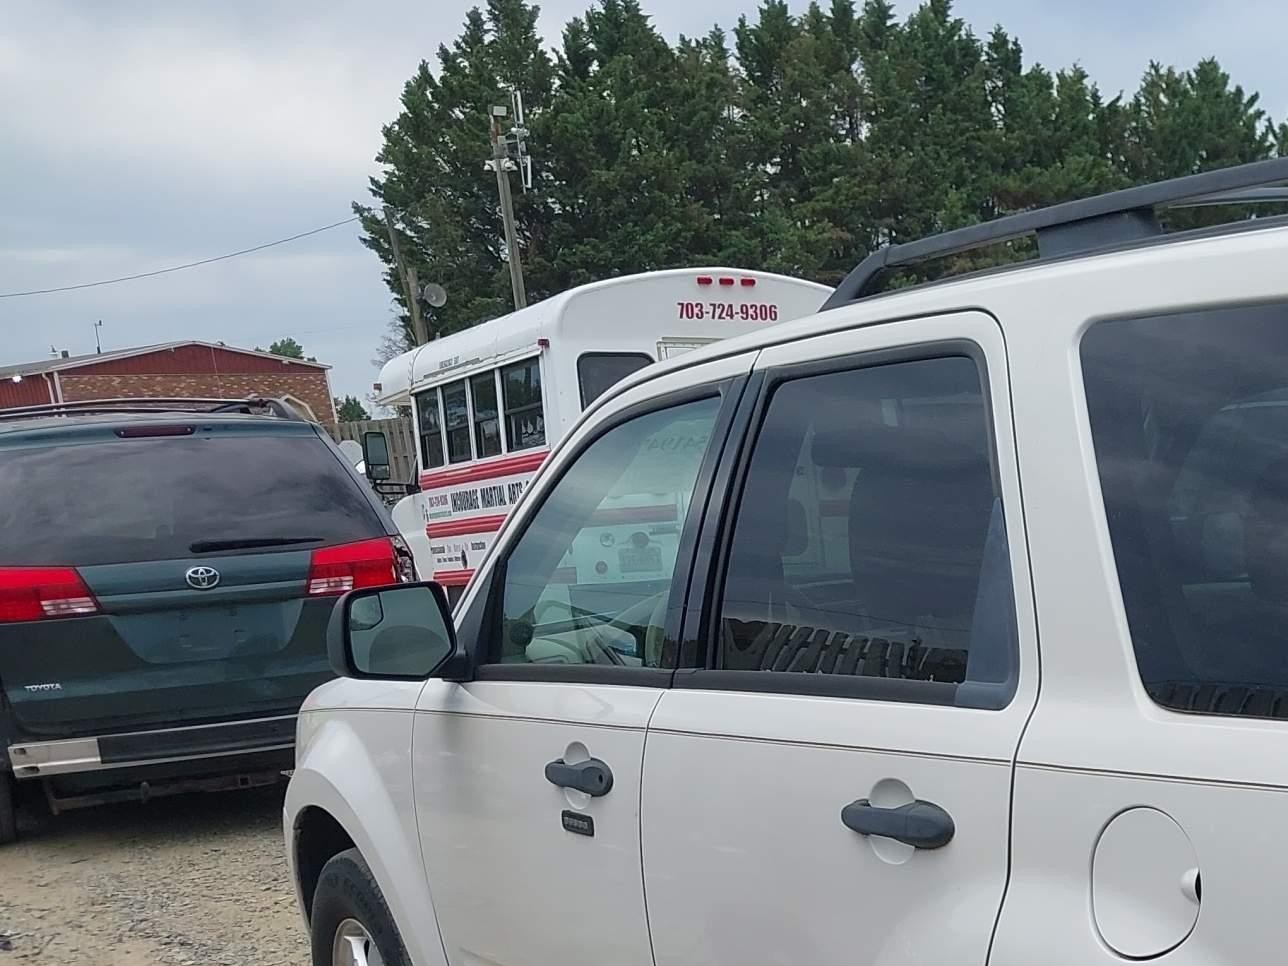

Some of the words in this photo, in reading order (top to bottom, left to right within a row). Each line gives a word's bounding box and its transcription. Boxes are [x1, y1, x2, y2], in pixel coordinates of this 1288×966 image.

[677, 302, 778, 321] 703-724-9306
[480, 485, 507, 508] MARTIAL
[24, 683, 63, 692] TOYOTA
